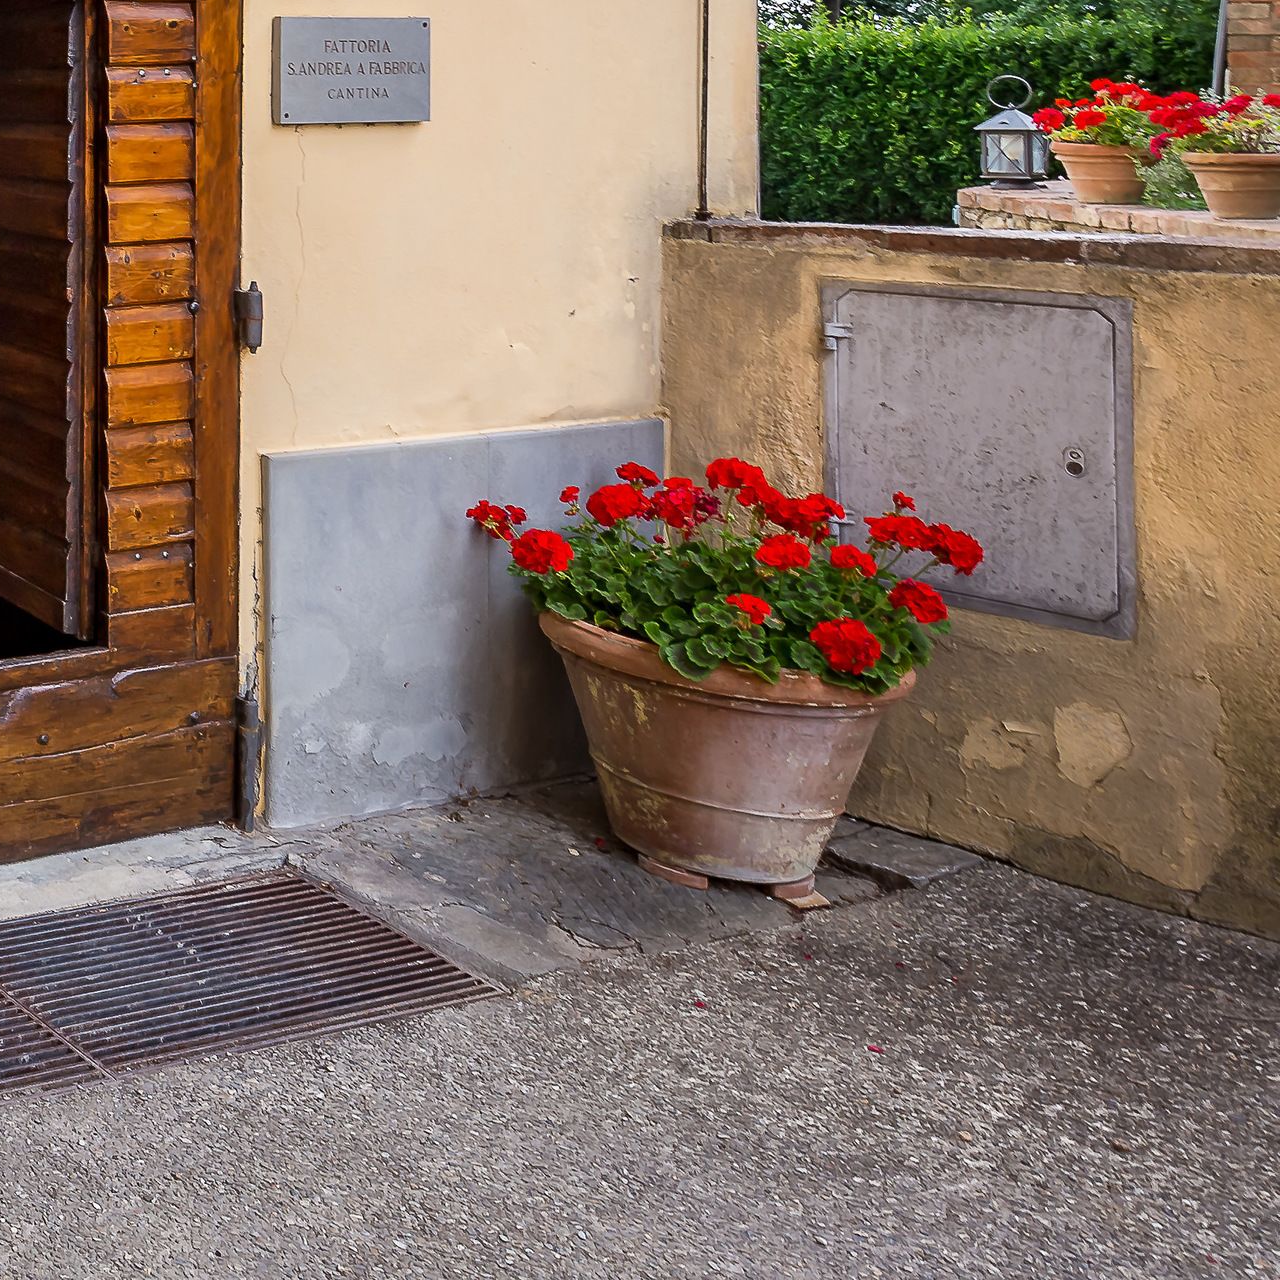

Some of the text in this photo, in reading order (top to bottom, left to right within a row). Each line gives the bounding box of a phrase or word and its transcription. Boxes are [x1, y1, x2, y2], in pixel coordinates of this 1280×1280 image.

[323, 39, 392, 54] FATTORIA
[287, 62, 426, 76] S.ANDREA A FABBRICA
[327, 87, 390, 100] CANTINA
